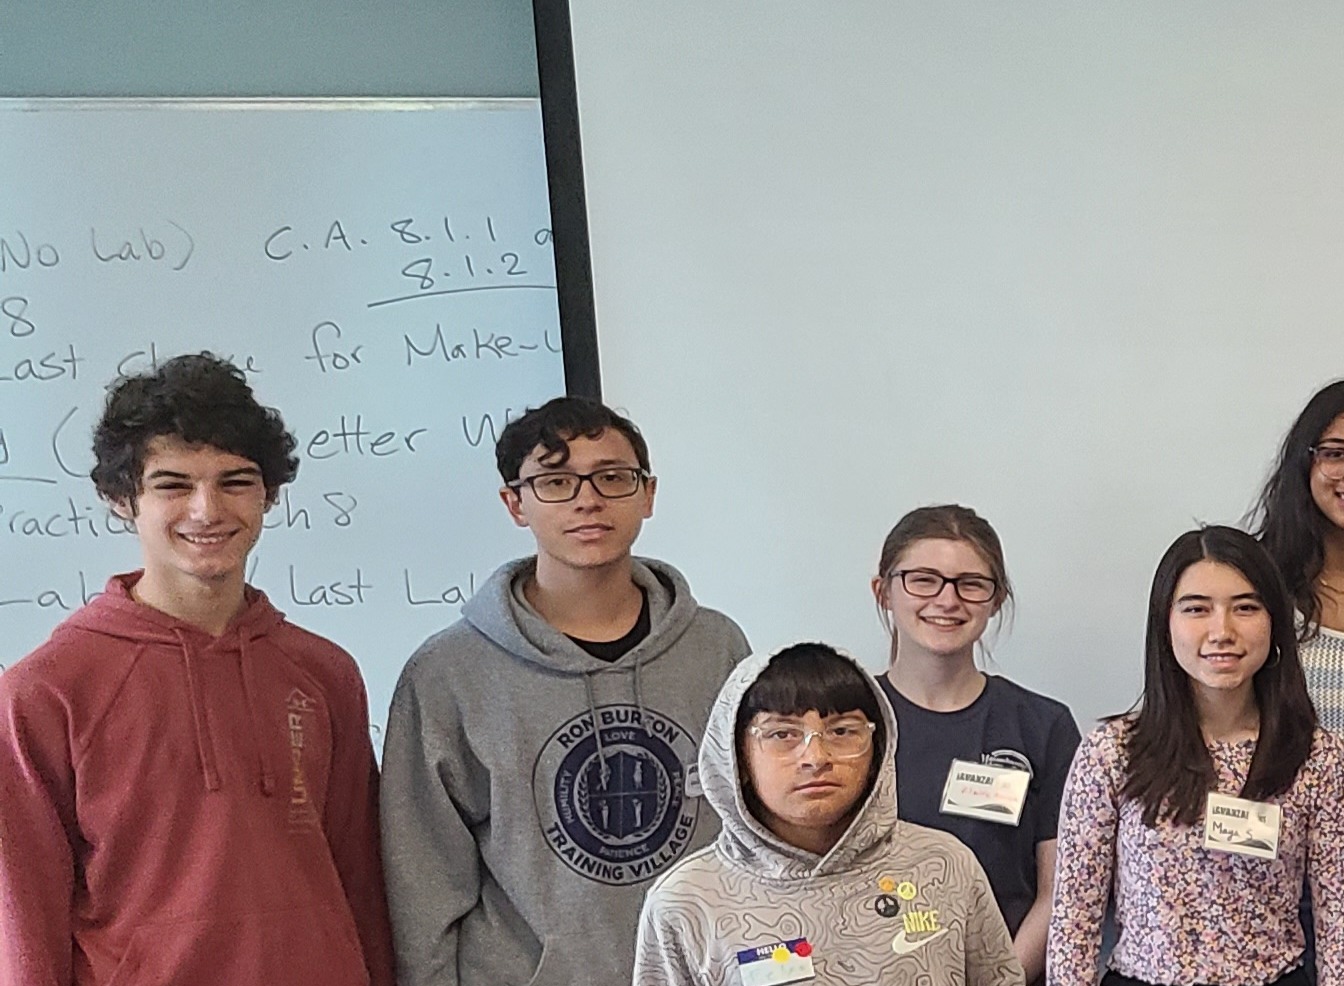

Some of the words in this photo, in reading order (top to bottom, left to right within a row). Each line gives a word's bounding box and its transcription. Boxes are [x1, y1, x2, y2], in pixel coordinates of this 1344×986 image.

[390, 216, 497, 244] 8.1.1
[401, 253, 528, 290] 8.1.2
[1, 297, 35, 337] 8
[304, 321, 364, 373] for
[307, 414, 428, 459] etter
[323, 491, 358, 527] 8
[556, 715, 595, 749] RON
[602, 730, 636, 742] LOVE
[558, 768, 576, 825] HUMILITY
[547, 822, 624, 881] TRAINING
[629, 814, 694, 878] VILLAGE
[598, 842, 651, 859] PATIENCE
[902, 909, 941, 934] NIKE
